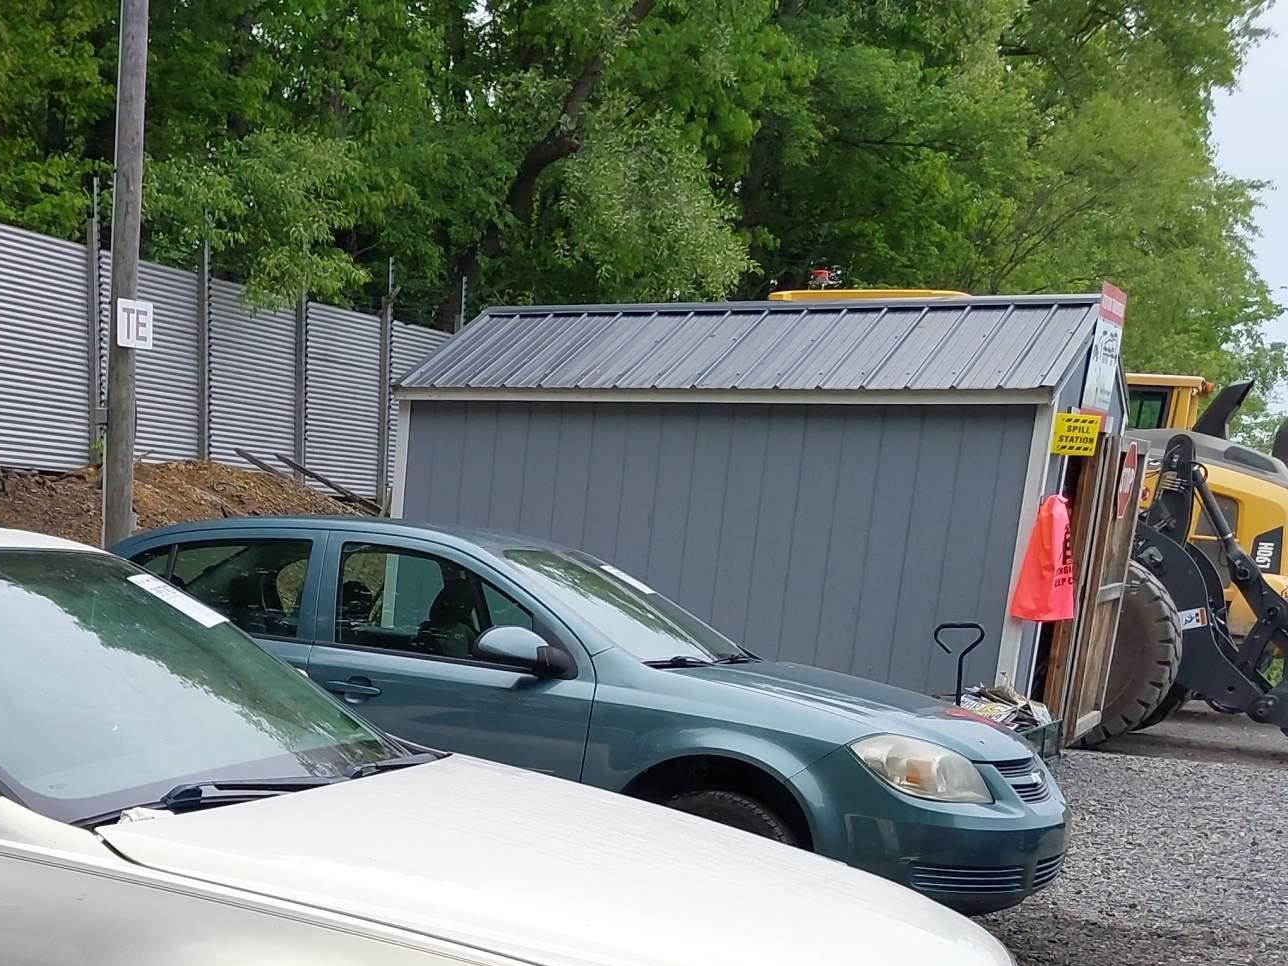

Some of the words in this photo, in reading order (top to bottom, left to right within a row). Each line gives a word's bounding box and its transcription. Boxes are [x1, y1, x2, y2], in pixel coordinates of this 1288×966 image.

[122, 307, 148, 342] TE
[1066, 425, 1091, 434] SPILL
[1058, 435, 1095, 444] STATION
[1255, 542, 1275, 569] L90H
